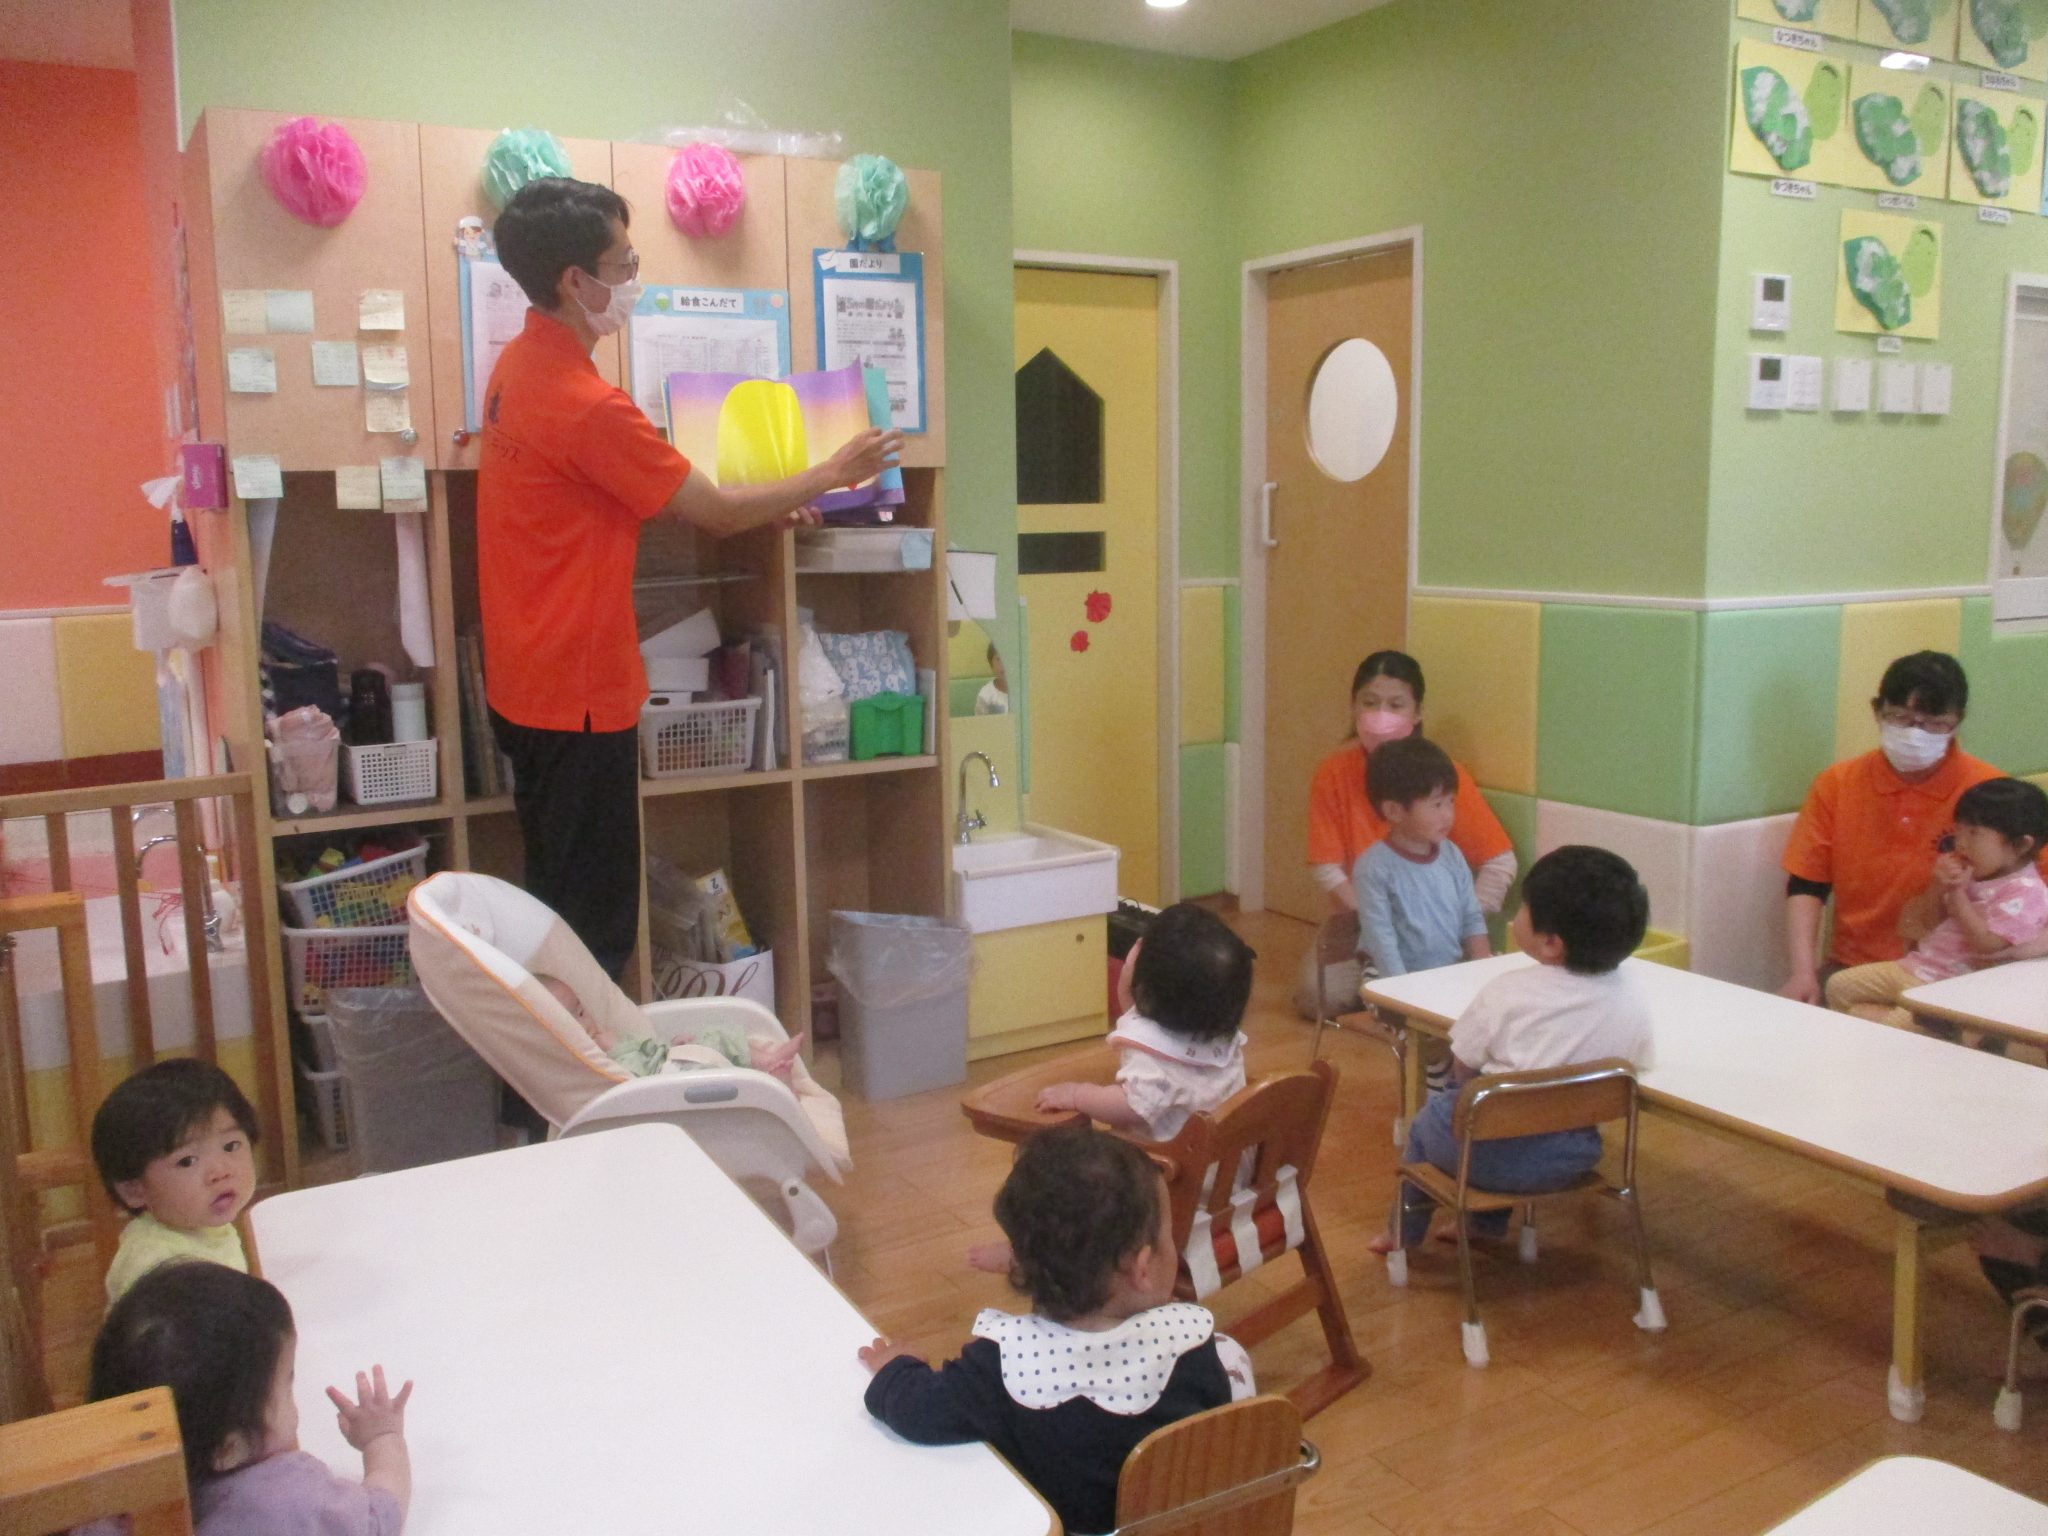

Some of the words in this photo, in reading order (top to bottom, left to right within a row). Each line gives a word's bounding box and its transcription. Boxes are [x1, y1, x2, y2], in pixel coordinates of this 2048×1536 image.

[849, 258, 882, 269] 園だより
[680, 296, 737, 309] 給食こんだて
